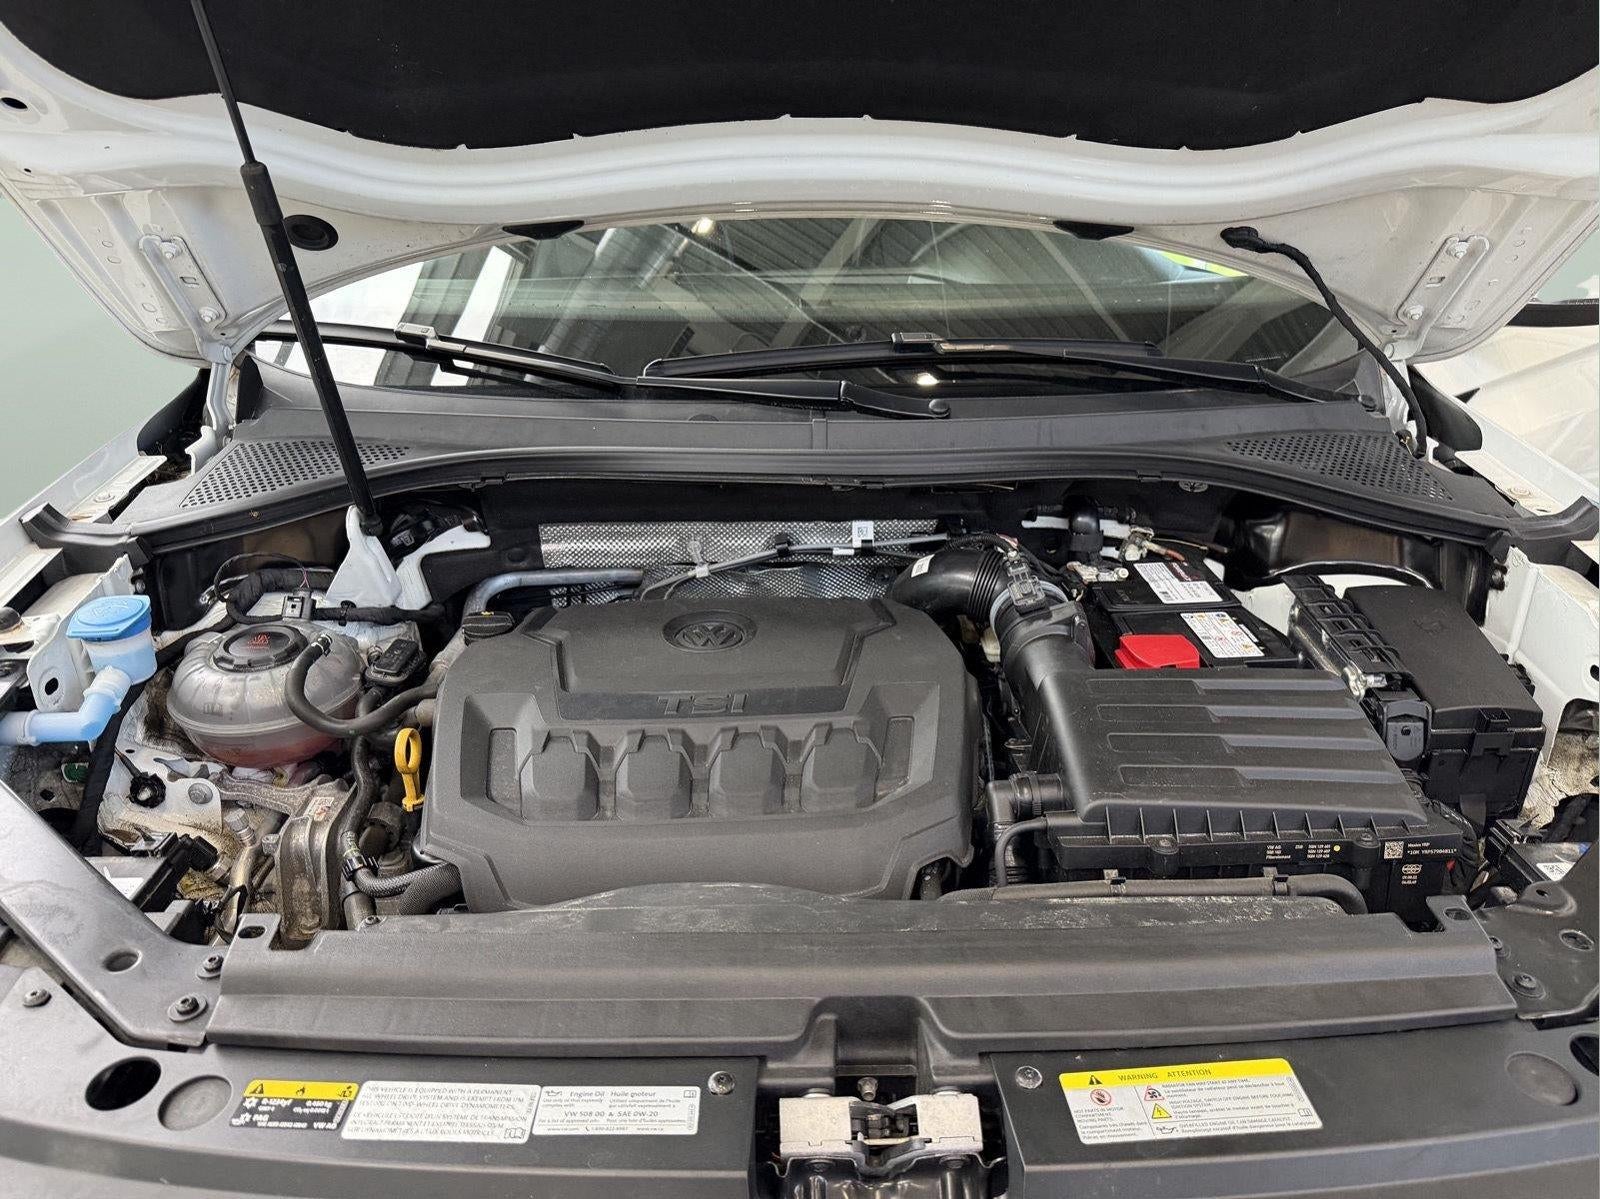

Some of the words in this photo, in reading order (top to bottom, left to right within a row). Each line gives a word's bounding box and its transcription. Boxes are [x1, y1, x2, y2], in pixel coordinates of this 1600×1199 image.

[657, 693, 748, 715] TSI
[1118, 1073, 1158, 1081] WARNING
[1167, 1069, 1212, 1077] ATTENTION
